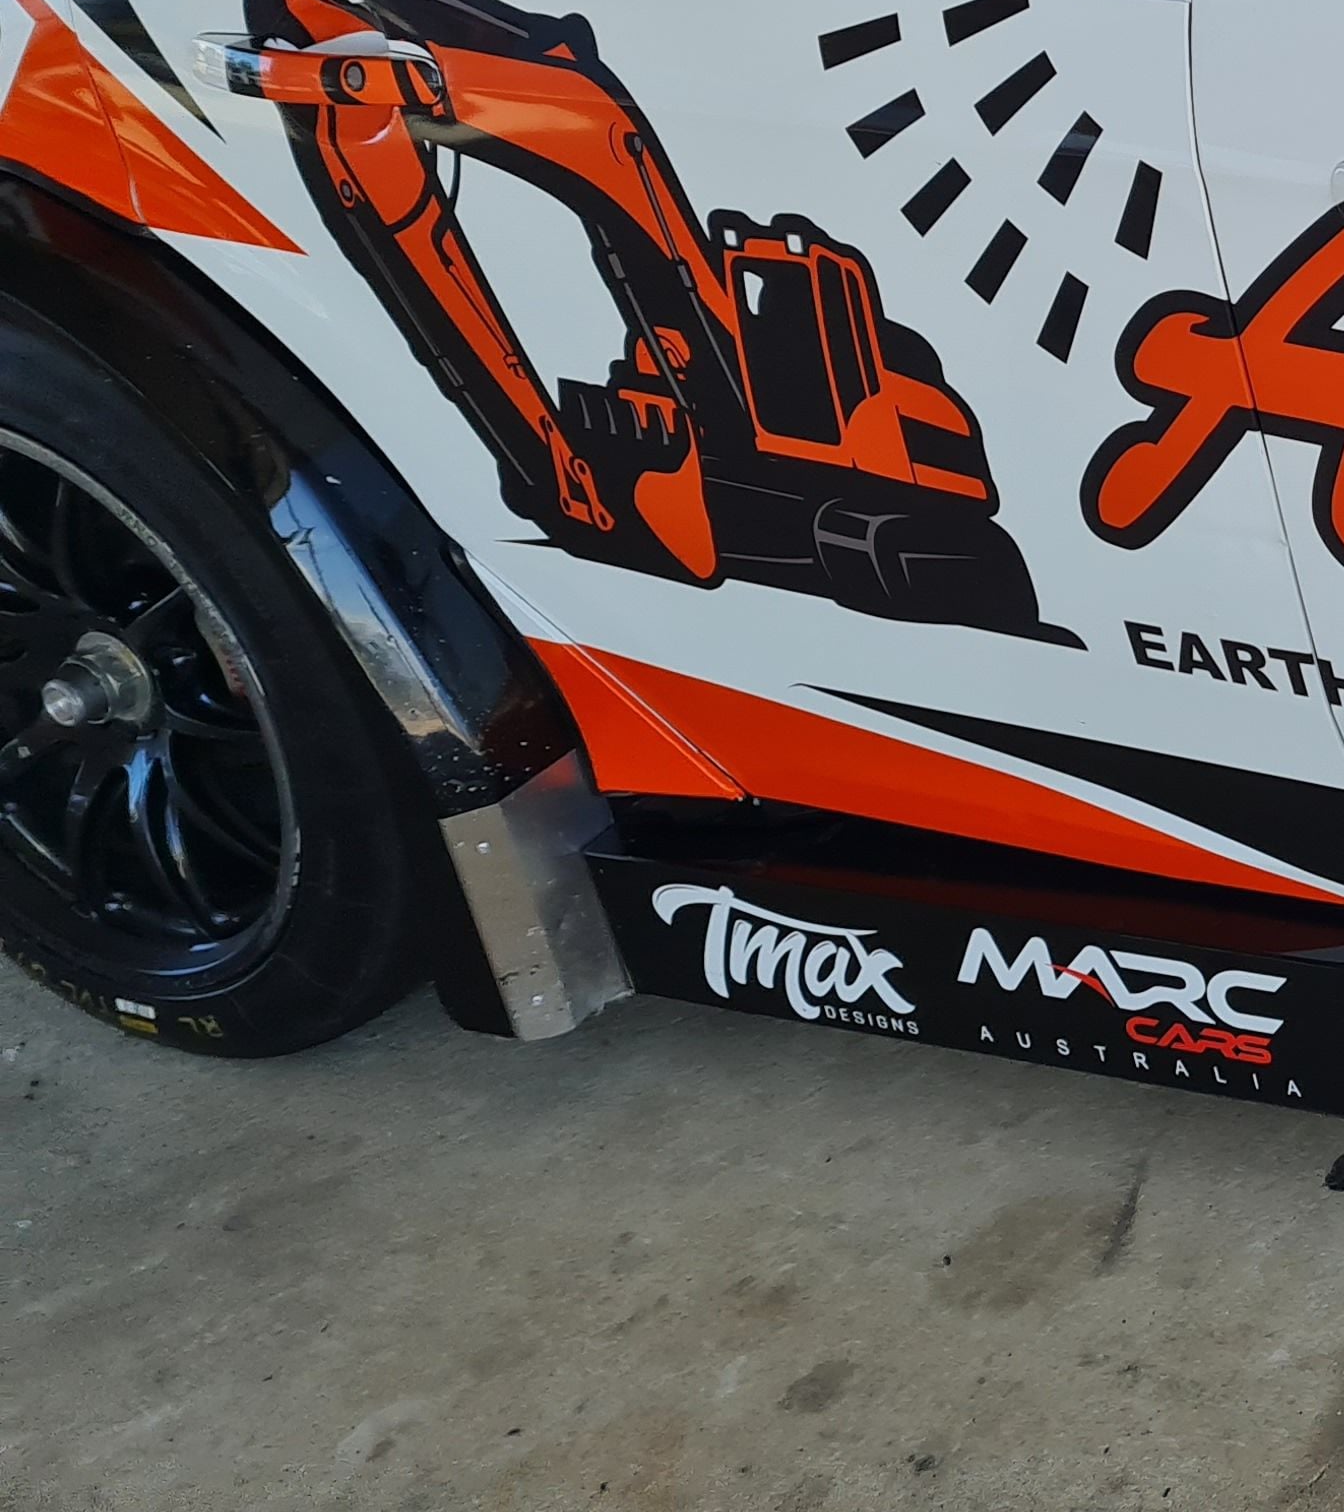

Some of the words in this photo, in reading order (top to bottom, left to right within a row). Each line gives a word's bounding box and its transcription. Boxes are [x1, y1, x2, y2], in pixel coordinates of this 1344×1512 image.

[652, 883, 916, 1020] Tmax
[957, 927, 1288, 1034] MARC
[823, 1004, 920, 1036] DESIGNS
[1125, 1015, 1272, 1064] CARS
[979, 1024, 1303, 1097] AUSTRALIA
